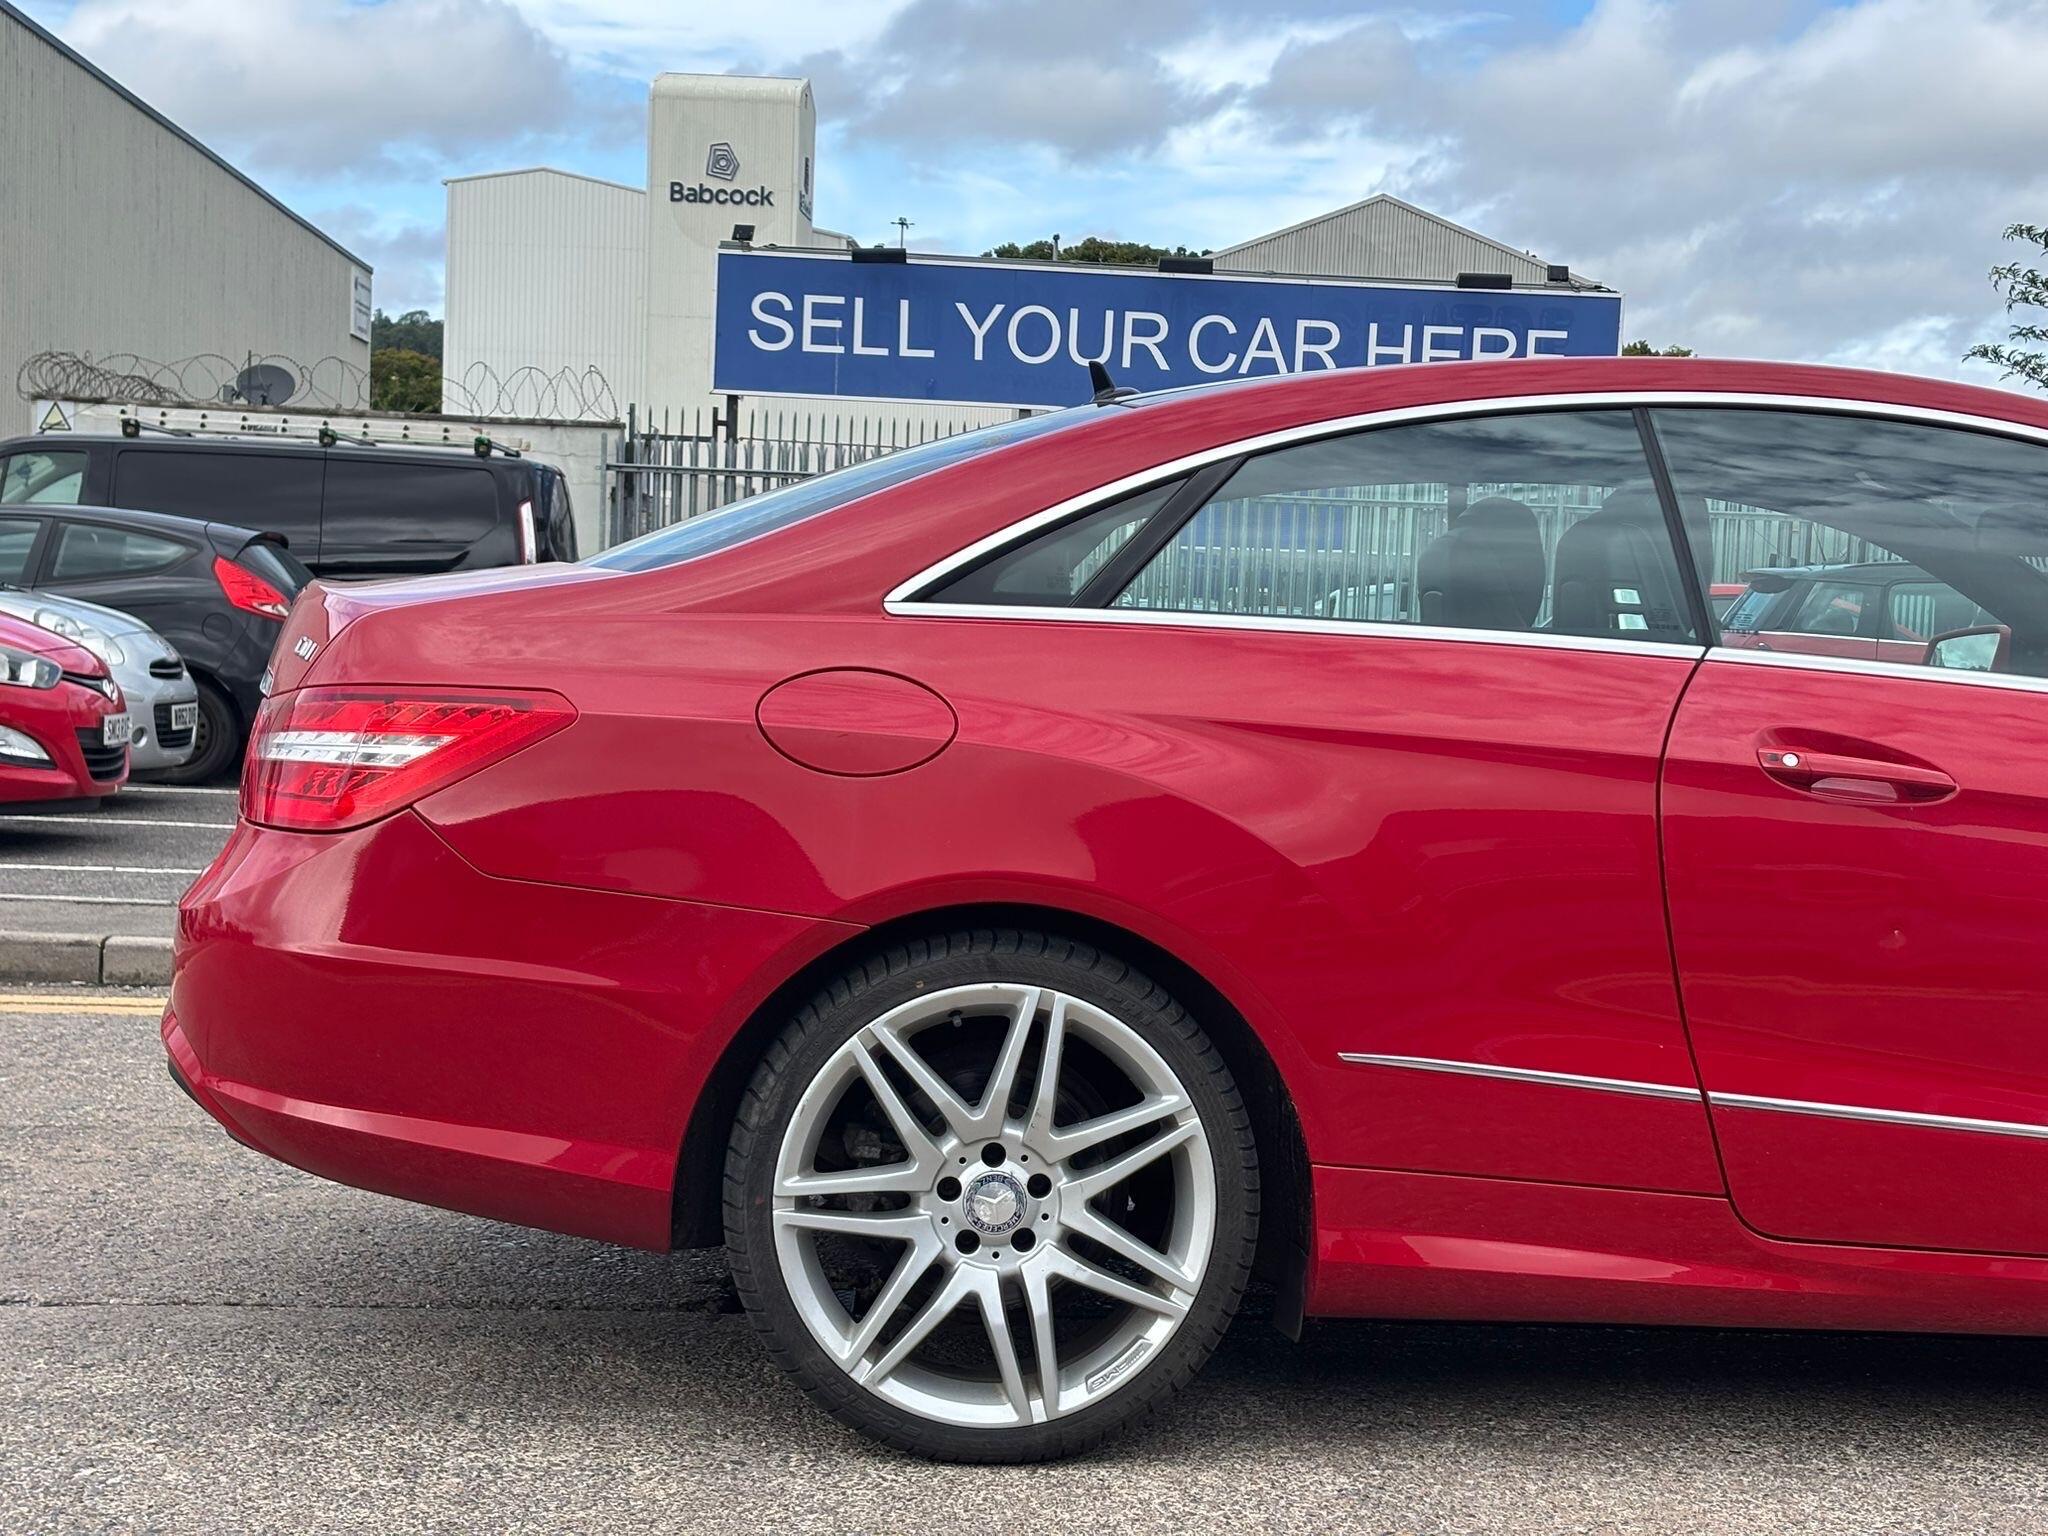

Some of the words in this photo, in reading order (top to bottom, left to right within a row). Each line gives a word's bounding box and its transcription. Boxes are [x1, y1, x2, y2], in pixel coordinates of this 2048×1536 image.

[670, 181, 773, 206] Babcock
[748, 291, 935, 358] SELL
[955, 302, 1171, 371] YOUR
[1188, 314, 1340, 373] CAR
